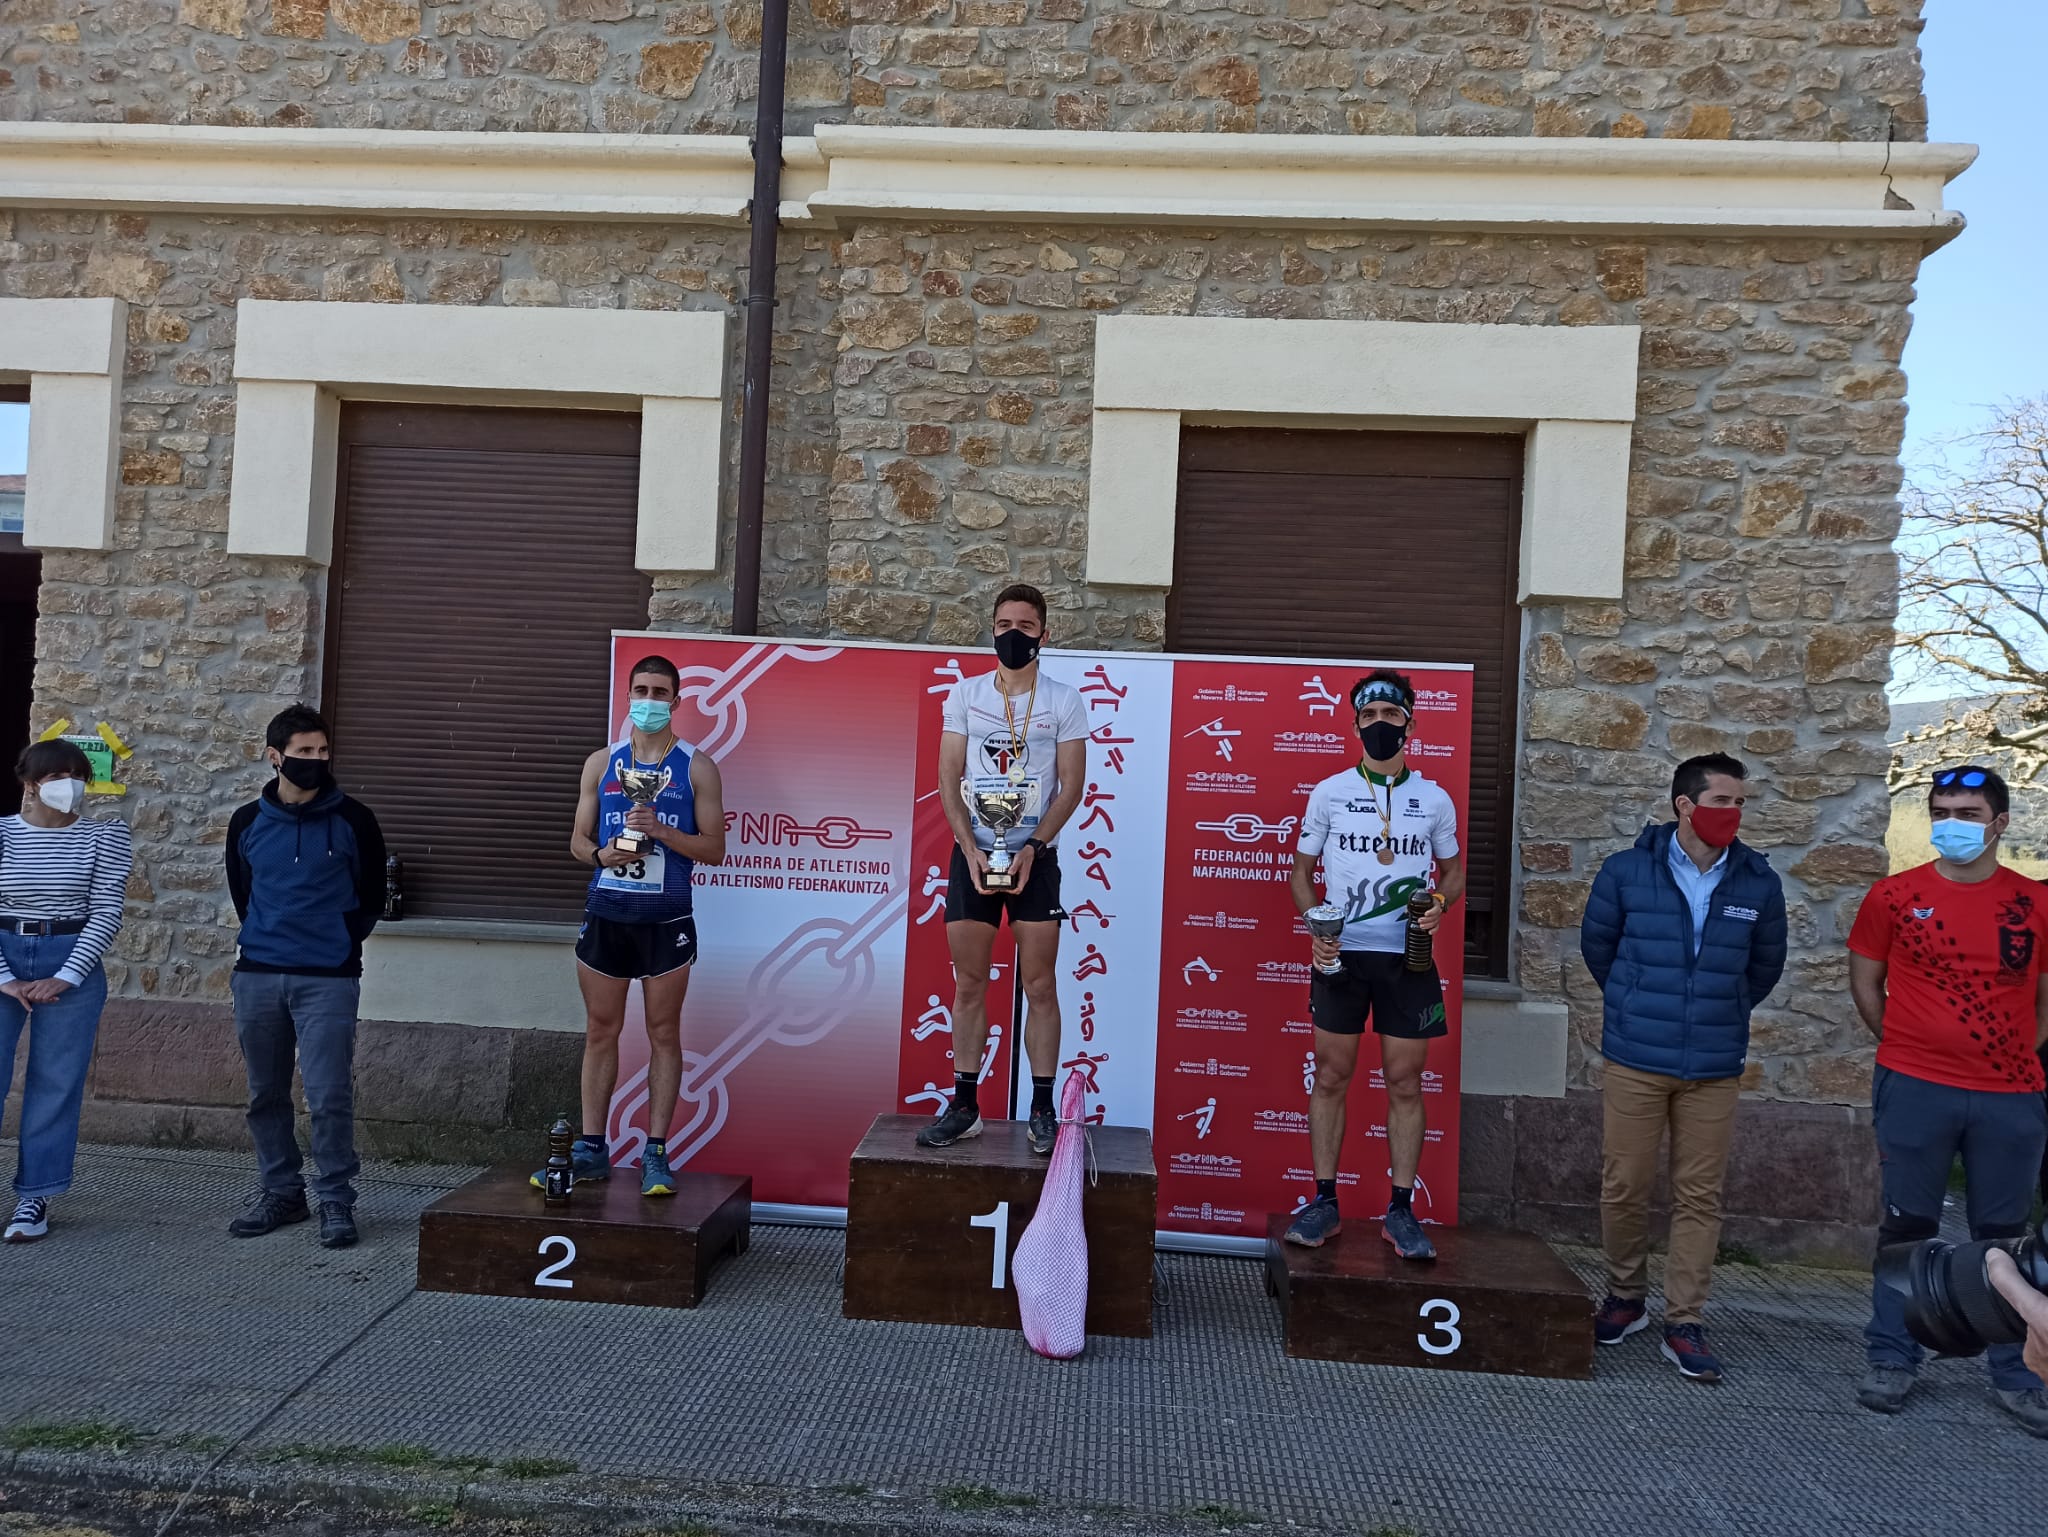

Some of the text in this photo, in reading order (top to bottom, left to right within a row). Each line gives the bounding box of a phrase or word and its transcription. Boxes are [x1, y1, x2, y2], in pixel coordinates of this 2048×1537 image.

[1339, 832, 1426, 856] etxenike
[788, 858, 804, 870] DE
[810, 858, 890, 875] ATLETISMO
[1194, 848, 1272, 864] FEDERACIÓN
[710, 874, 784, 890] ATLETISMO
[788, 877, 889, 894] FEDERAKUNTZA
[1193, 866, 1270, 881] NAFARROAKO
[970, 1202, 1008, 1288] 1
[534, 1235, 576, 1288] 2
[1418, 1299, 1461, 1355] 3
